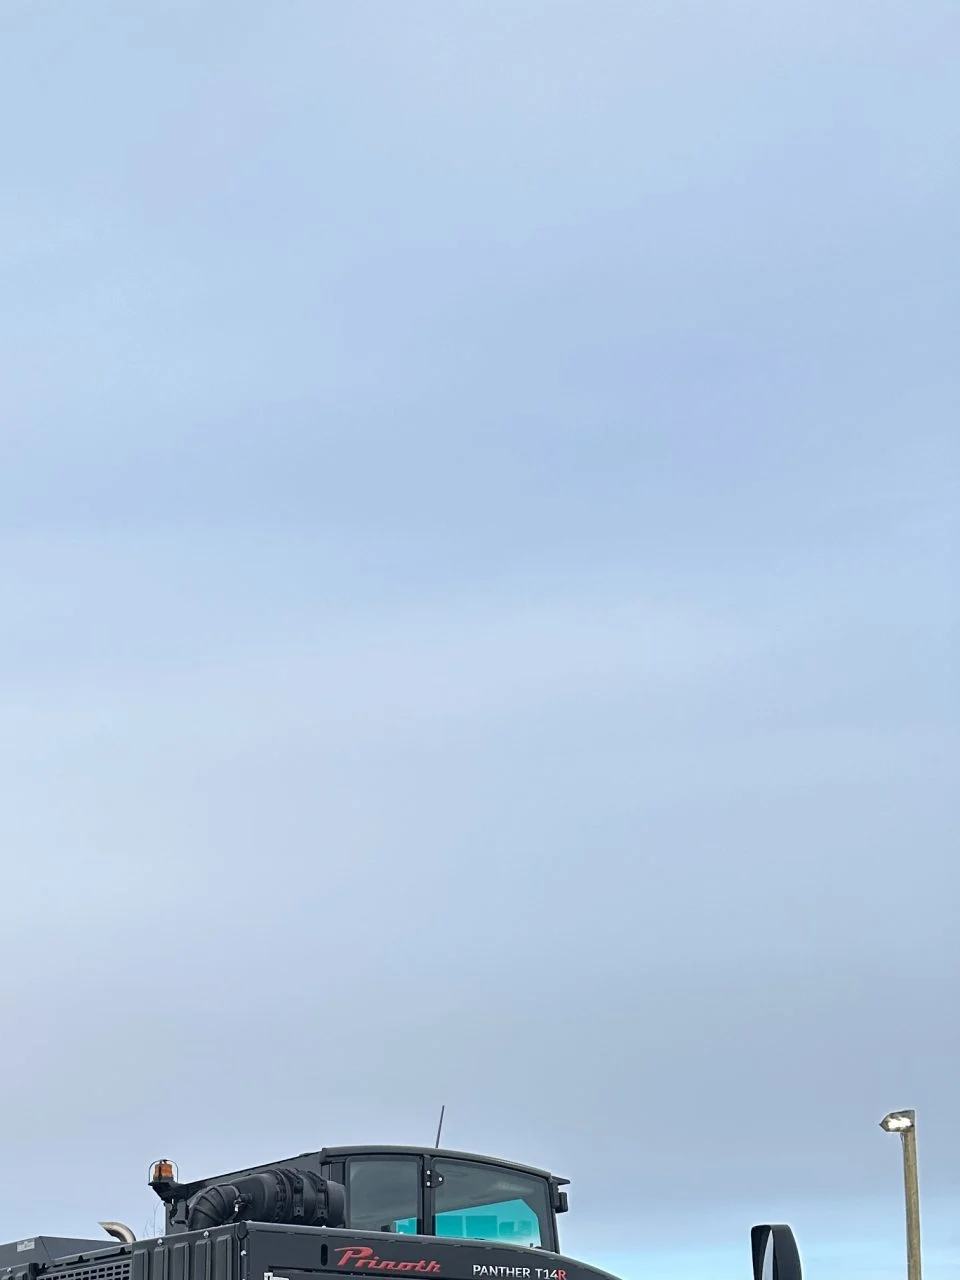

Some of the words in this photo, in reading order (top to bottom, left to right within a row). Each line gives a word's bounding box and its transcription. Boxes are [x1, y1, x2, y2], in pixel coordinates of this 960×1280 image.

[334, 1246, 440, 1272] Prinoth
[472, 1264, 530, 1278] PANTHER
[535, 1268, 567, 1280] T14R
